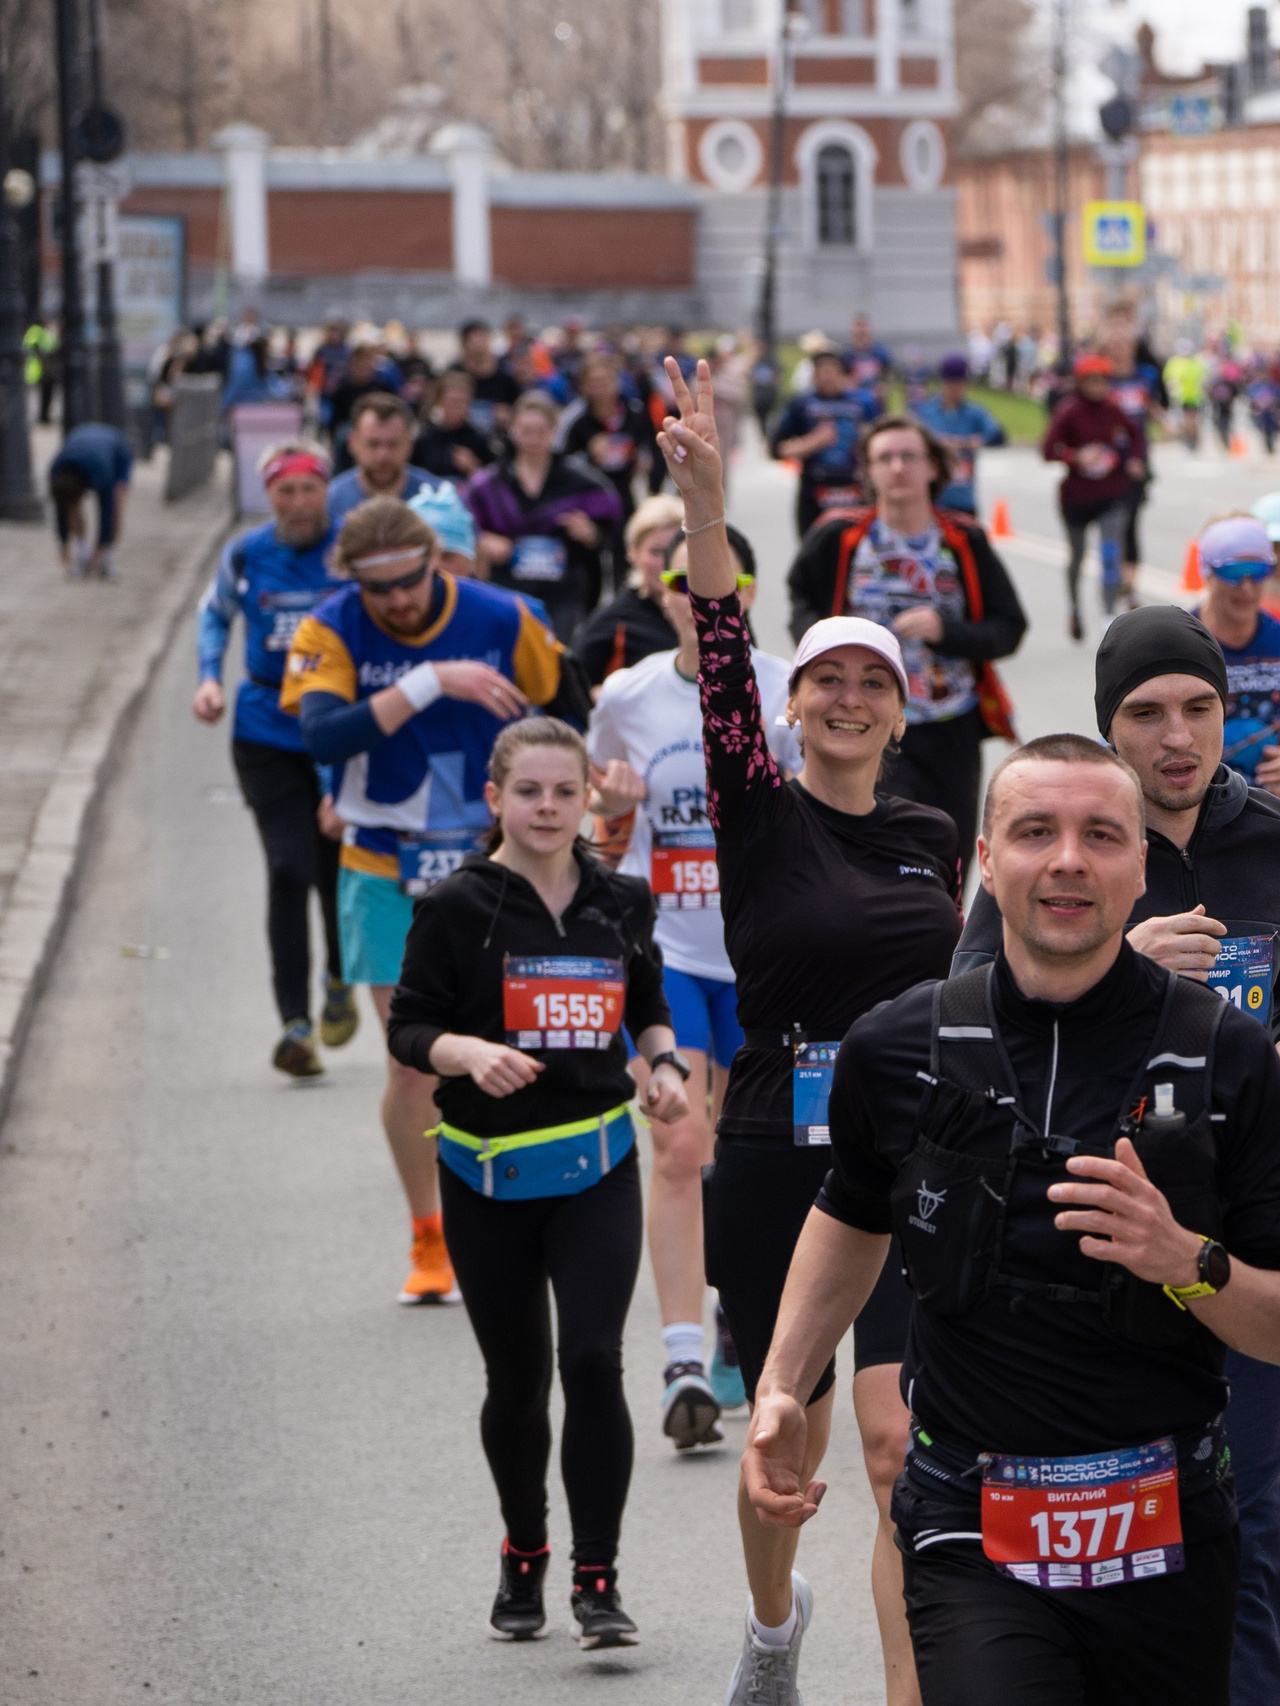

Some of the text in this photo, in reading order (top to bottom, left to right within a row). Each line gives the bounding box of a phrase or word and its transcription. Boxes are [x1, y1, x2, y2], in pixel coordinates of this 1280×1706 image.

[532, 993, 605, 1028] 1555
[1040, 1458, 1120, 1473] Я ПРОСТО
[1040, 1466, 1120, 1483] КОСМОС
[990, 1492, 1000, 1501] 10
[1047, 1487, 1107, 1503] ВИТАЛИЙ
[1144, 1499, 1158, 1515] E
[1030, 1501, 1135, 1559] 1377
